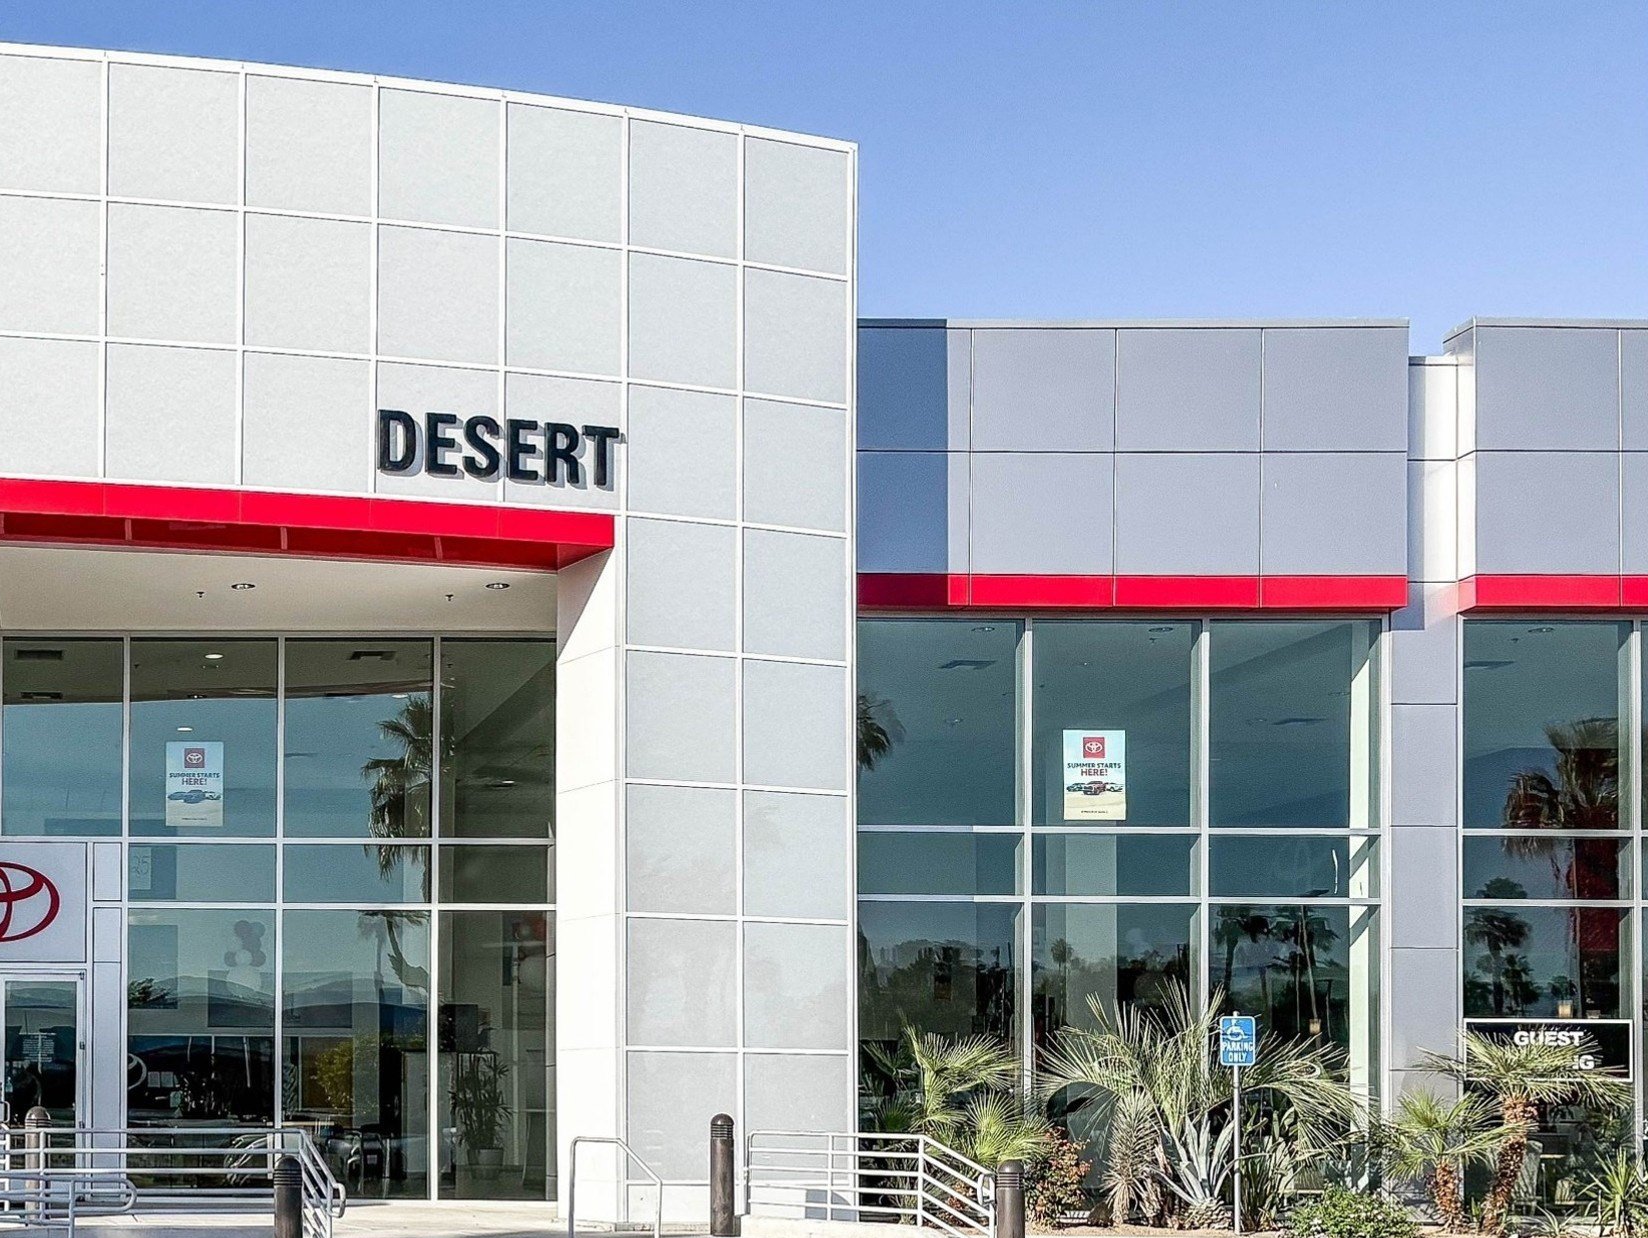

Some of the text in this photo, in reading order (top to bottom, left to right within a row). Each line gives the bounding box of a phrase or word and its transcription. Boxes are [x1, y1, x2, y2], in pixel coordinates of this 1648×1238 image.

[377, 409, 620, 487] DESERT
[1513, 1031, 1584, 1046] GUEST
[1222, 1041, 1254, 1051] PARKING
[1228, 1052, 1248, 1063] ONLY
